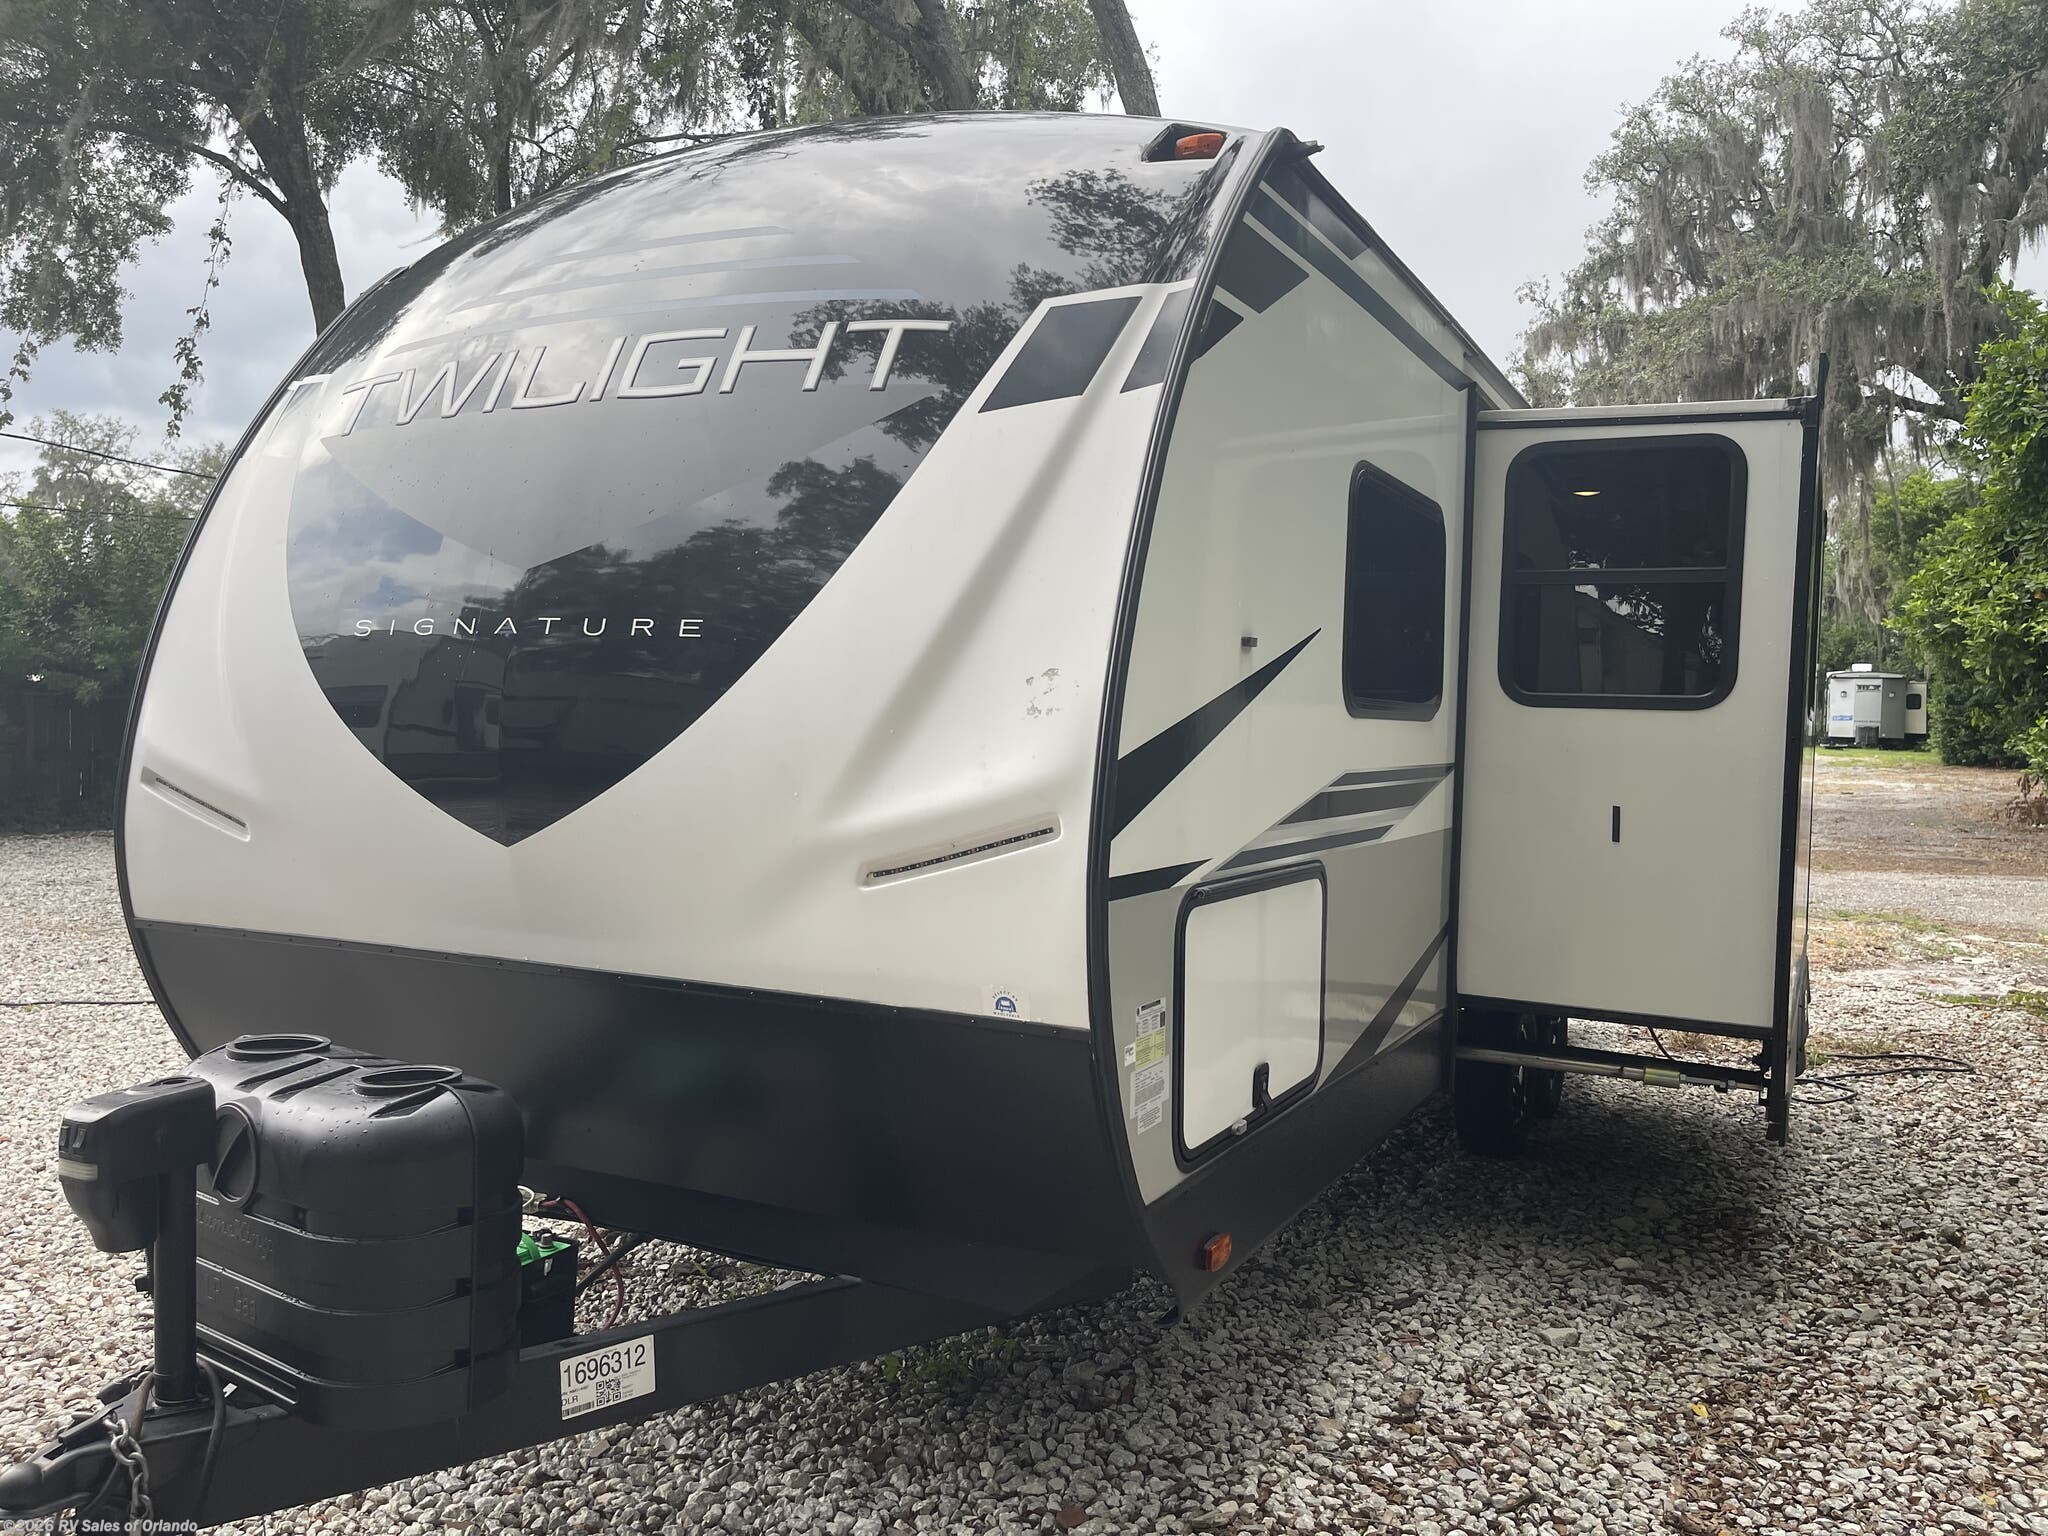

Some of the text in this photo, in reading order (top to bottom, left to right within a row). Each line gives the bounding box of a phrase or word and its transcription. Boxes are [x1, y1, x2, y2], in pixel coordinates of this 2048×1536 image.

[342, 319, 952, 437] TWILIGHT
[354, 616, 703, 638] SIGNATURE
[563, 1344, 646, 1388] 1696312
